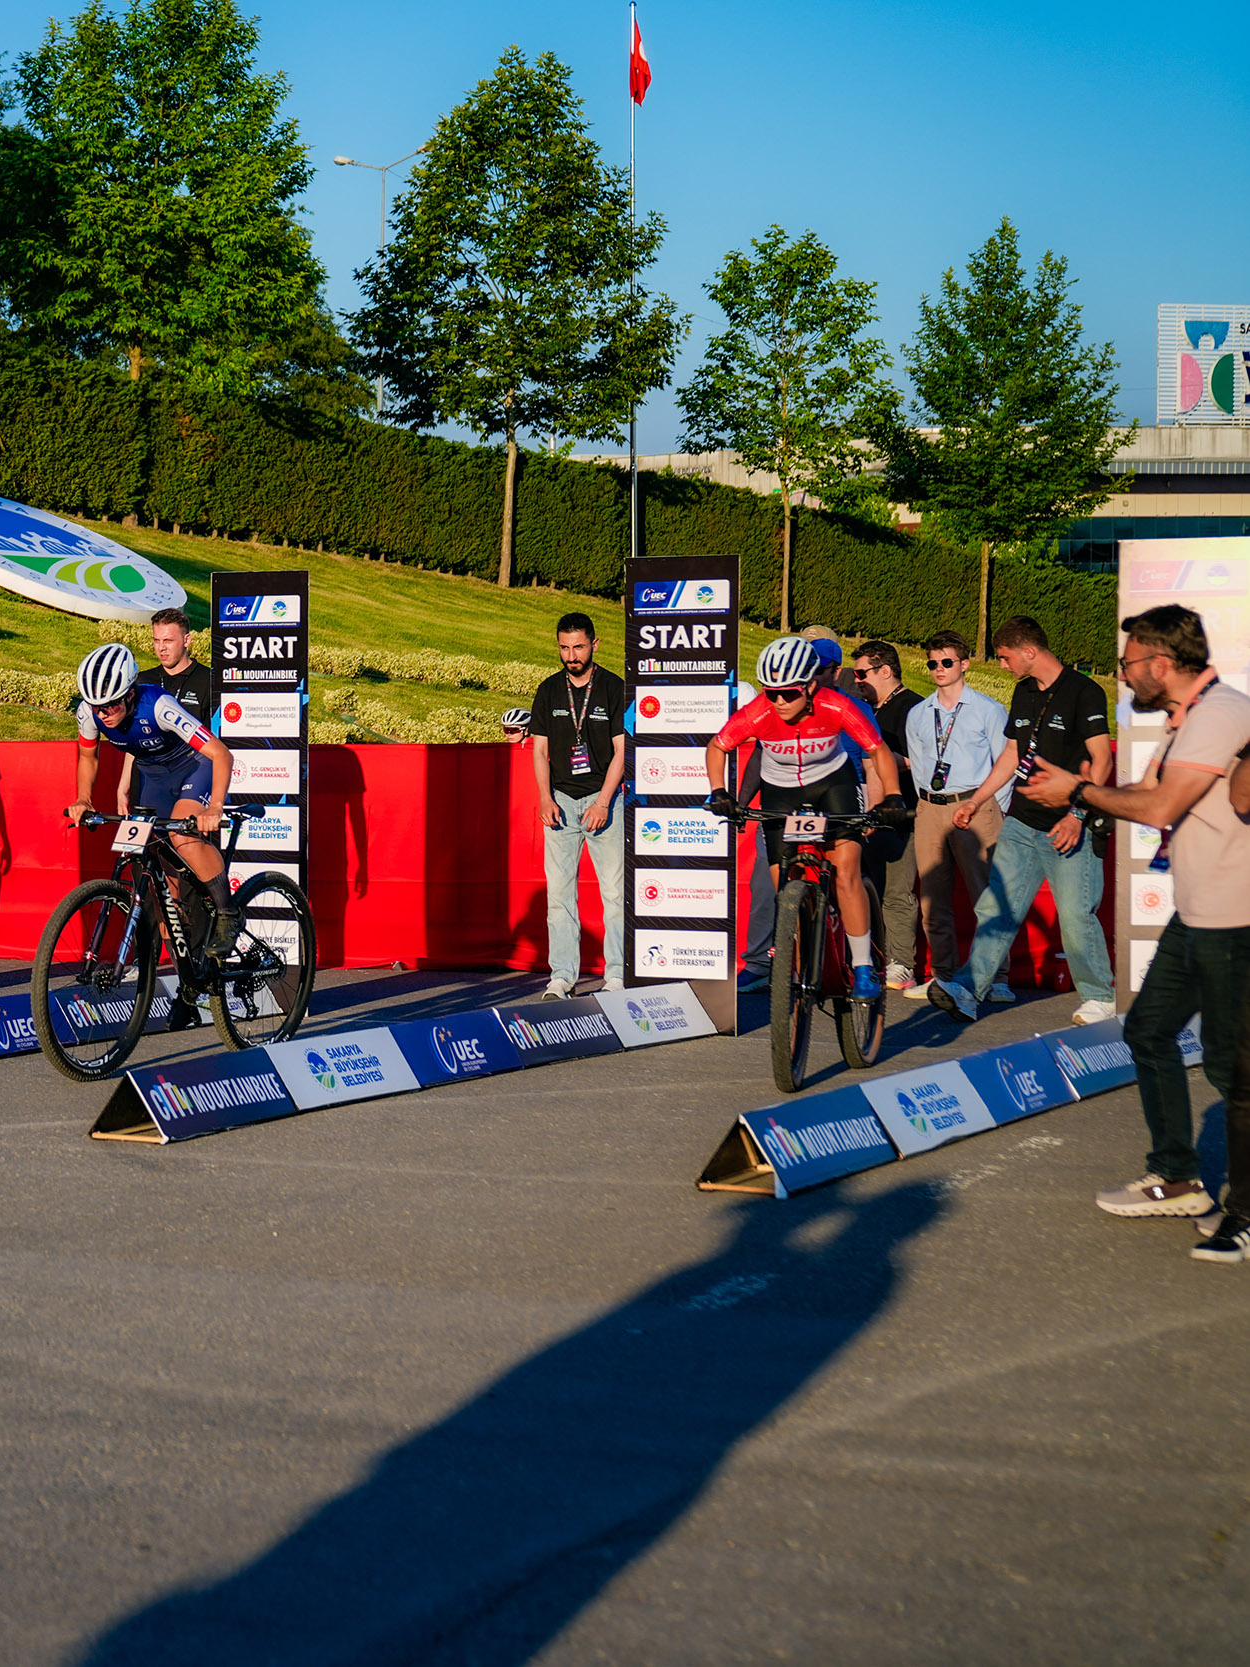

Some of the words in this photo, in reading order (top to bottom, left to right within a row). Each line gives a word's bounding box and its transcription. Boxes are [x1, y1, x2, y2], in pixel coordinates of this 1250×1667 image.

[638, 624, 727, 649] START
[223, 636, 297, 659] START
[223, 668, 242, 679] CITY
[244, 670, 297, 679] MOUNTAINBIKE
[638, 659, 661, 672] CITY
[663, 661, 726, 671] MOUNTAINBIKE
[163, 710, 192, 733] CIC
[142, 738, 161, 747] CIC
[128, 826, 138, 841] 9
[668, 828, 719, 836] BÜYÜKŞEHİR
[794, 819, 816, 832] 16
[668, 836, 714, 844] BELEDİYESİ
[672, 947, 696, 956] TÜRKİYE
[698, 948, 723, 957] BİSİKLET
[673, 958, 715, 967] FEDERASYONU
[641, 996, 670, 1007] SAKARYA
[67, 996, 101, 1028] CITY
[648, 1005, 686, 1020] BÜYÜKŞEHİR
[7, 1018, 37, 1038] UEC
[509, 1016, 543, 1050] CITY
[537, 1013, 613, 1046] MOUNTAINBIKE
[656, 1018, 688, 1031] BELEDİYESİ
[325, 1044, 363, 1059] SAKARYA
[452, 1038, 485, 1060] UEC
[333, 1054, 381, 1073] BÜYÜKŞEHİR
[341, 1070, 384, 1087] BELEDİYESİ
[1015, 1070, 1044, 1096] UEC
[150, 1079, 193, 1121] CITY
[187, 1073, 285, 1113] MOUNTAINBIKE
[910, 1082, 943, 1101] SAKARYA
[920, 1092, 962, 1116] BÜYÜKŞEHİR
[930, 1110, 967, 1130] BELEDİYESİ
[764, 1122, 805, 1169] CITY
[796, 1116, 888, 1162] MOUNTAINBIKE
